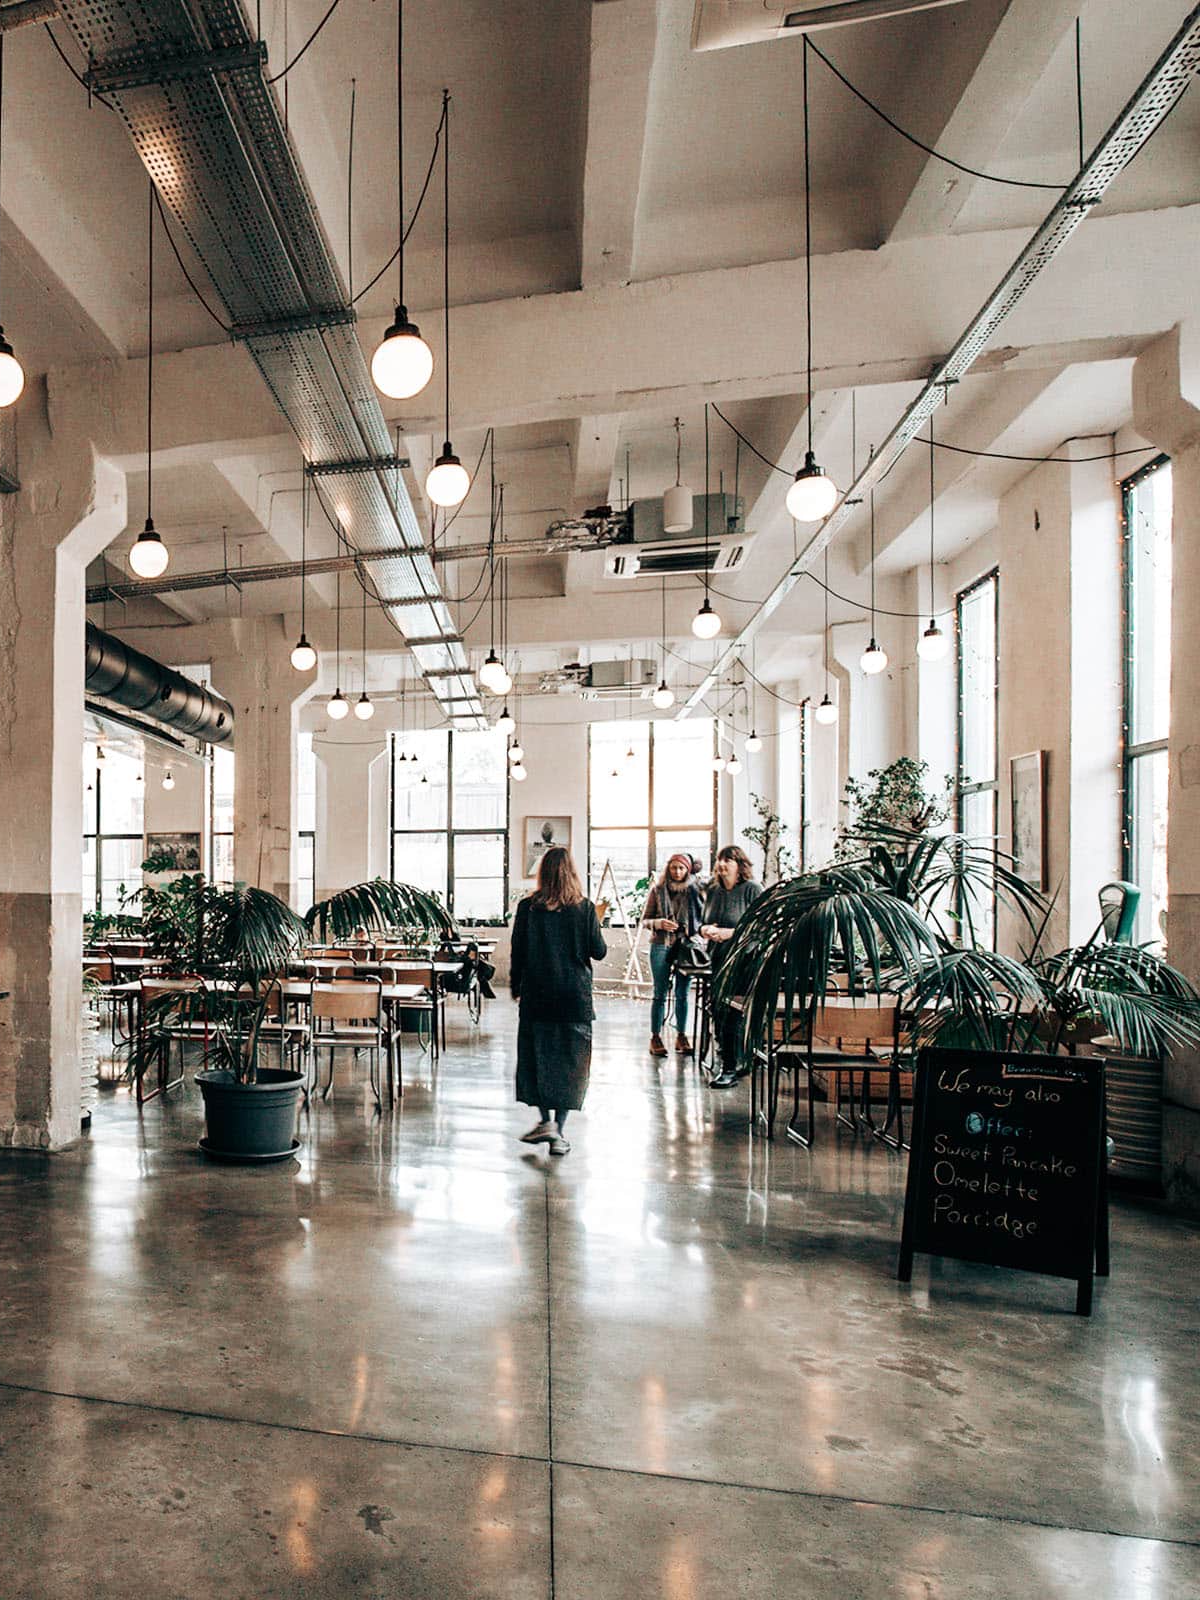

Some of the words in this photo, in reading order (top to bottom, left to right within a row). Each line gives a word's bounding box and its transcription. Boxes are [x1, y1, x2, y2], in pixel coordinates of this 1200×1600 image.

[937, 1068, 970, 1093] We
[976, 1083, 1014, 1107] may
[1024, 1084, 1061, 1102] also
[934, 1134, 991, 1161] Sweet
[1002, 1146, 1077, 1178] Pancake
[934, 1161, 1040, 1201] Omelette
[933, 1194, 1038, 1238] Porridge
